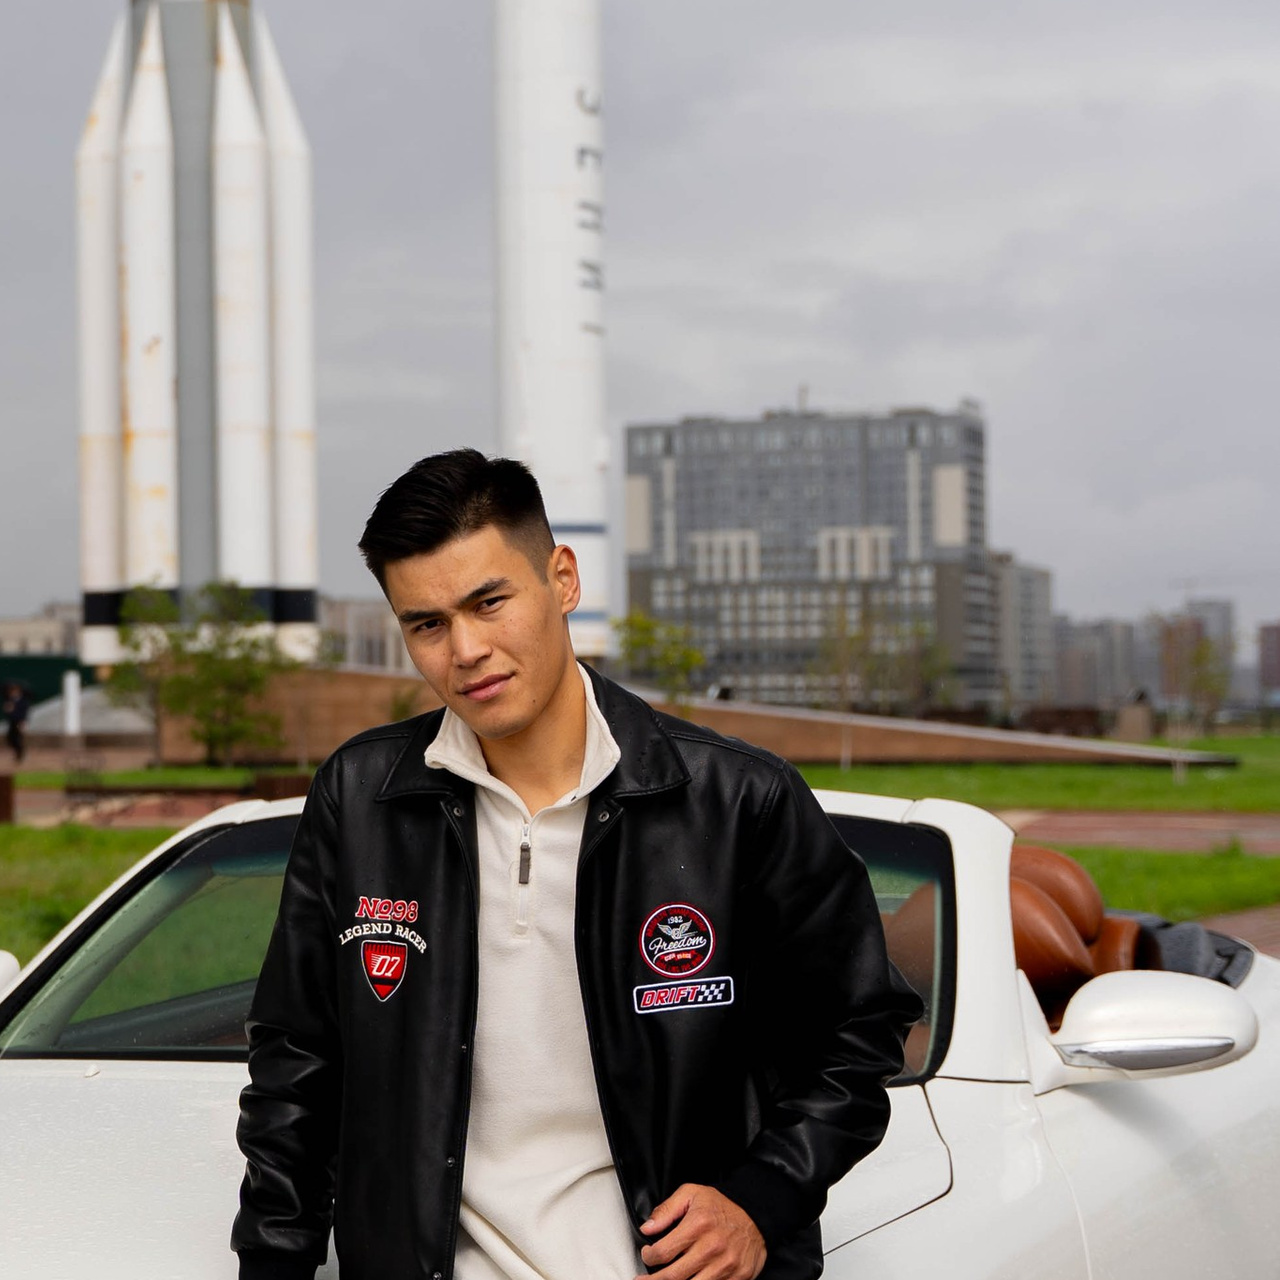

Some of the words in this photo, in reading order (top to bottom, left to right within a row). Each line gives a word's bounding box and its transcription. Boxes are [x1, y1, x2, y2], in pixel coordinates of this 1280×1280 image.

[339, 923, 392, 945] LEGEND
[395, 924, 427, 953] RACER
[649, 935, 707, 956] Freedom
[372, 955, 400, 976] 07
[640, 985, 700, 1008] DRIFT
